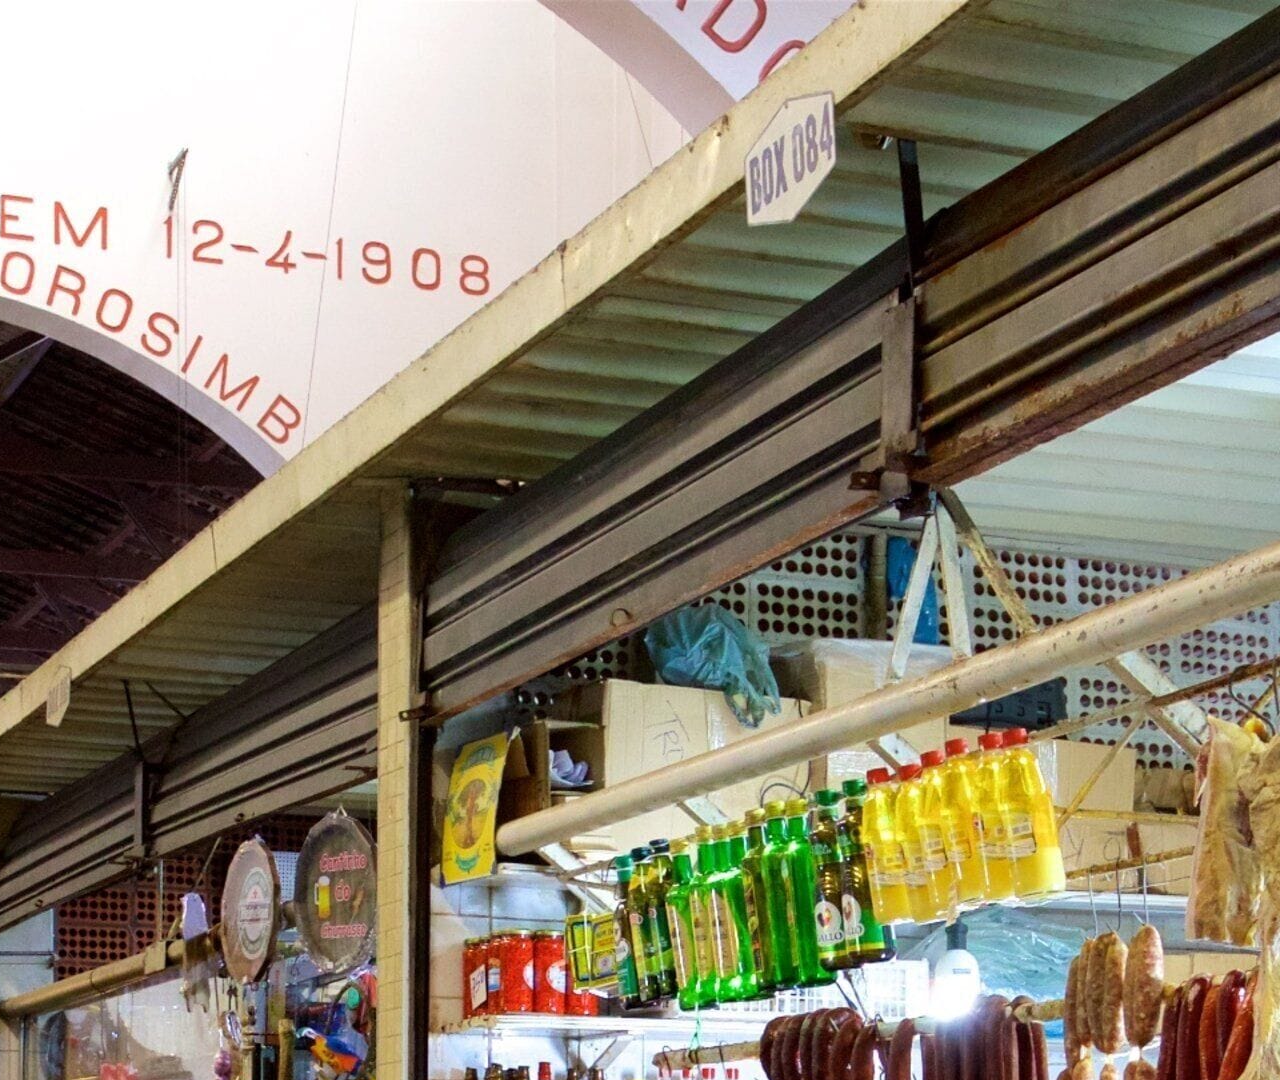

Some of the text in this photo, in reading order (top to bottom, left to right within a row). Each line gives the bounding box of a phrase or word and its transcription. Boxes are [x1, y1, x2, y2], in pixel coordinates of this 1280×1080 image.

[749, 102, 834, 217] BOX 084
[0, 195, 108, 251] EM
[161, 214, 490, 296] 12-4-1908
[0, 250, 304, 448] OROSIMB
